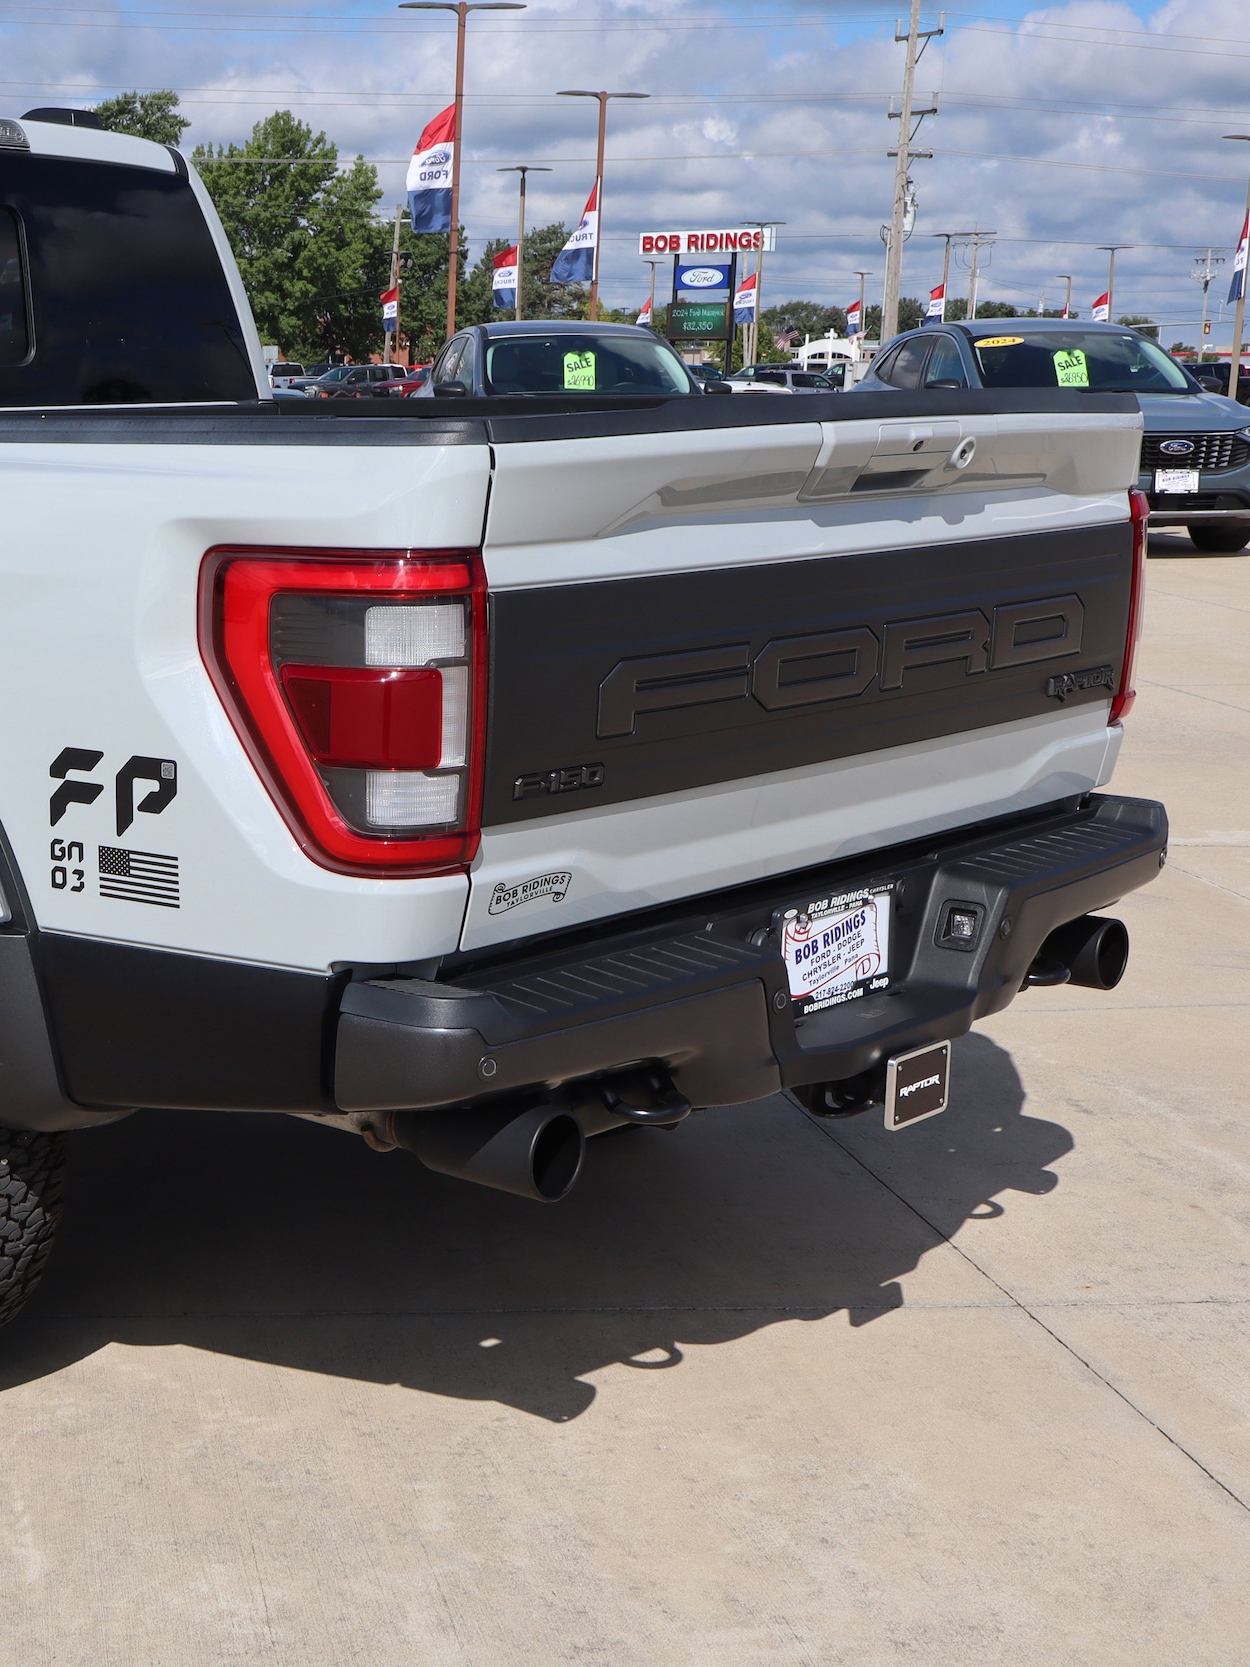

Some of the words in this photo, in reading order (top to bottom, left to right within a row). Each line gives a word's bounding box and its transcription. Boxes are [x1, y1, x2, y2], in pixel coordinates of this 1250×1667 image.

[642, 235, 681, 252] BOB
[687, 231, 764, 251] RIDINGS
[690, 271, 715, 283] Ford
[672, 309, 688, 317] 2024
[683, 322, 713, 331] $32,350
[983, 338, 1016, 346] 2024
[566, 357, 593, 373] SALE
[1057, 355, 1083, 371] SALE
[596, 592, 1085, 740] FORD
[1046, 664, 1115, 702] RAPTOR
[51, 866, 85, 893] 03
[495, 889, 518, 905] BOB
[522, 875, 566, 894] RIDINGS
[507, 886, 553, 907] TAYLORVILLE
[807, 899, 828, 914] BOB
[830, 888, 870, 907] RIDINGS
[795, 939, 819, 965] BOB
[823, 909, 866, 949] RIDINGS
[810, 949, 831, 966] FORD
[837, 930, 862, 950] DODGE
[802, 953, 842, 981] CHRYSLER
[848, 938, 865, 955] JEEP
[870, 977, 889, 989] Jeep
[804, 988, 864, 1014] BOBRIDINGS.COM
[899, 1073, 941, 1097] RAPTOR
